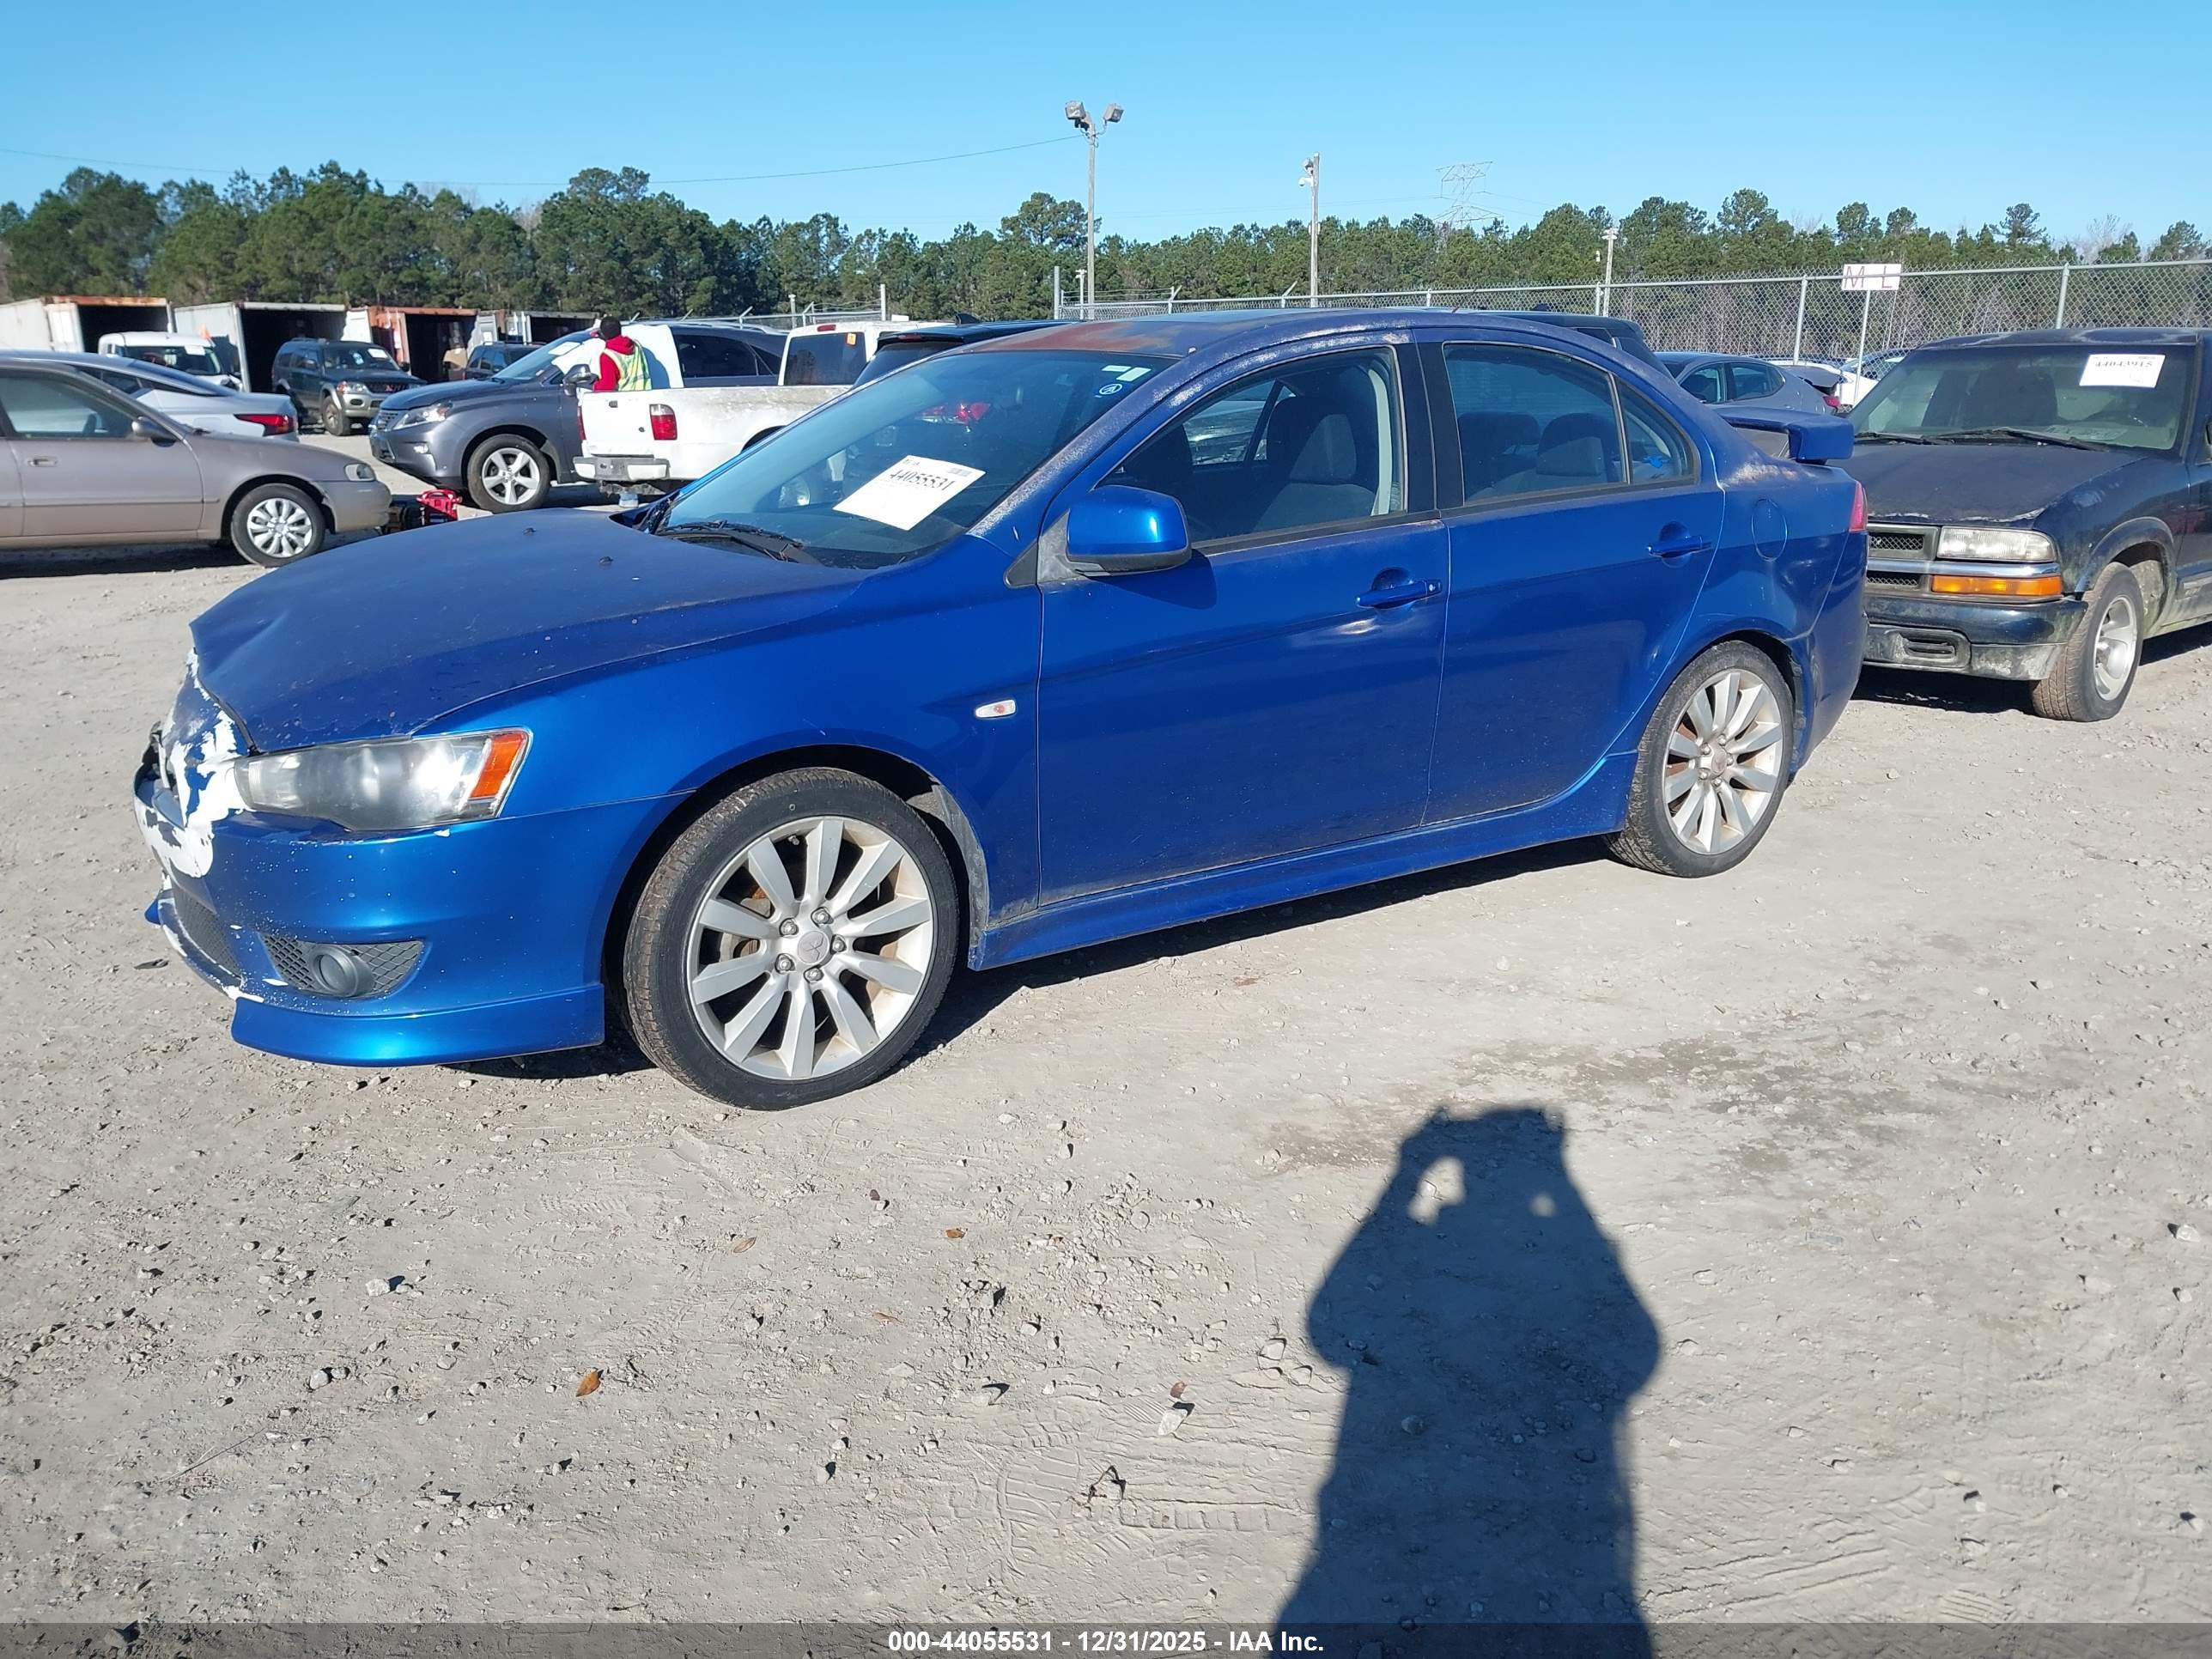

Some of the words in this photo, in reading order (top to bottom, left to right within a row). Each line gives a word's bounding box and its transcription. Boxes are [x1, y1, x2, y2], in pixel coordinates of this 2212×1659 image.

[1844, 265, 1865, 289] M
[1881, 265, 1893, 289] L
[890, 469, 957, 491] 44055531
